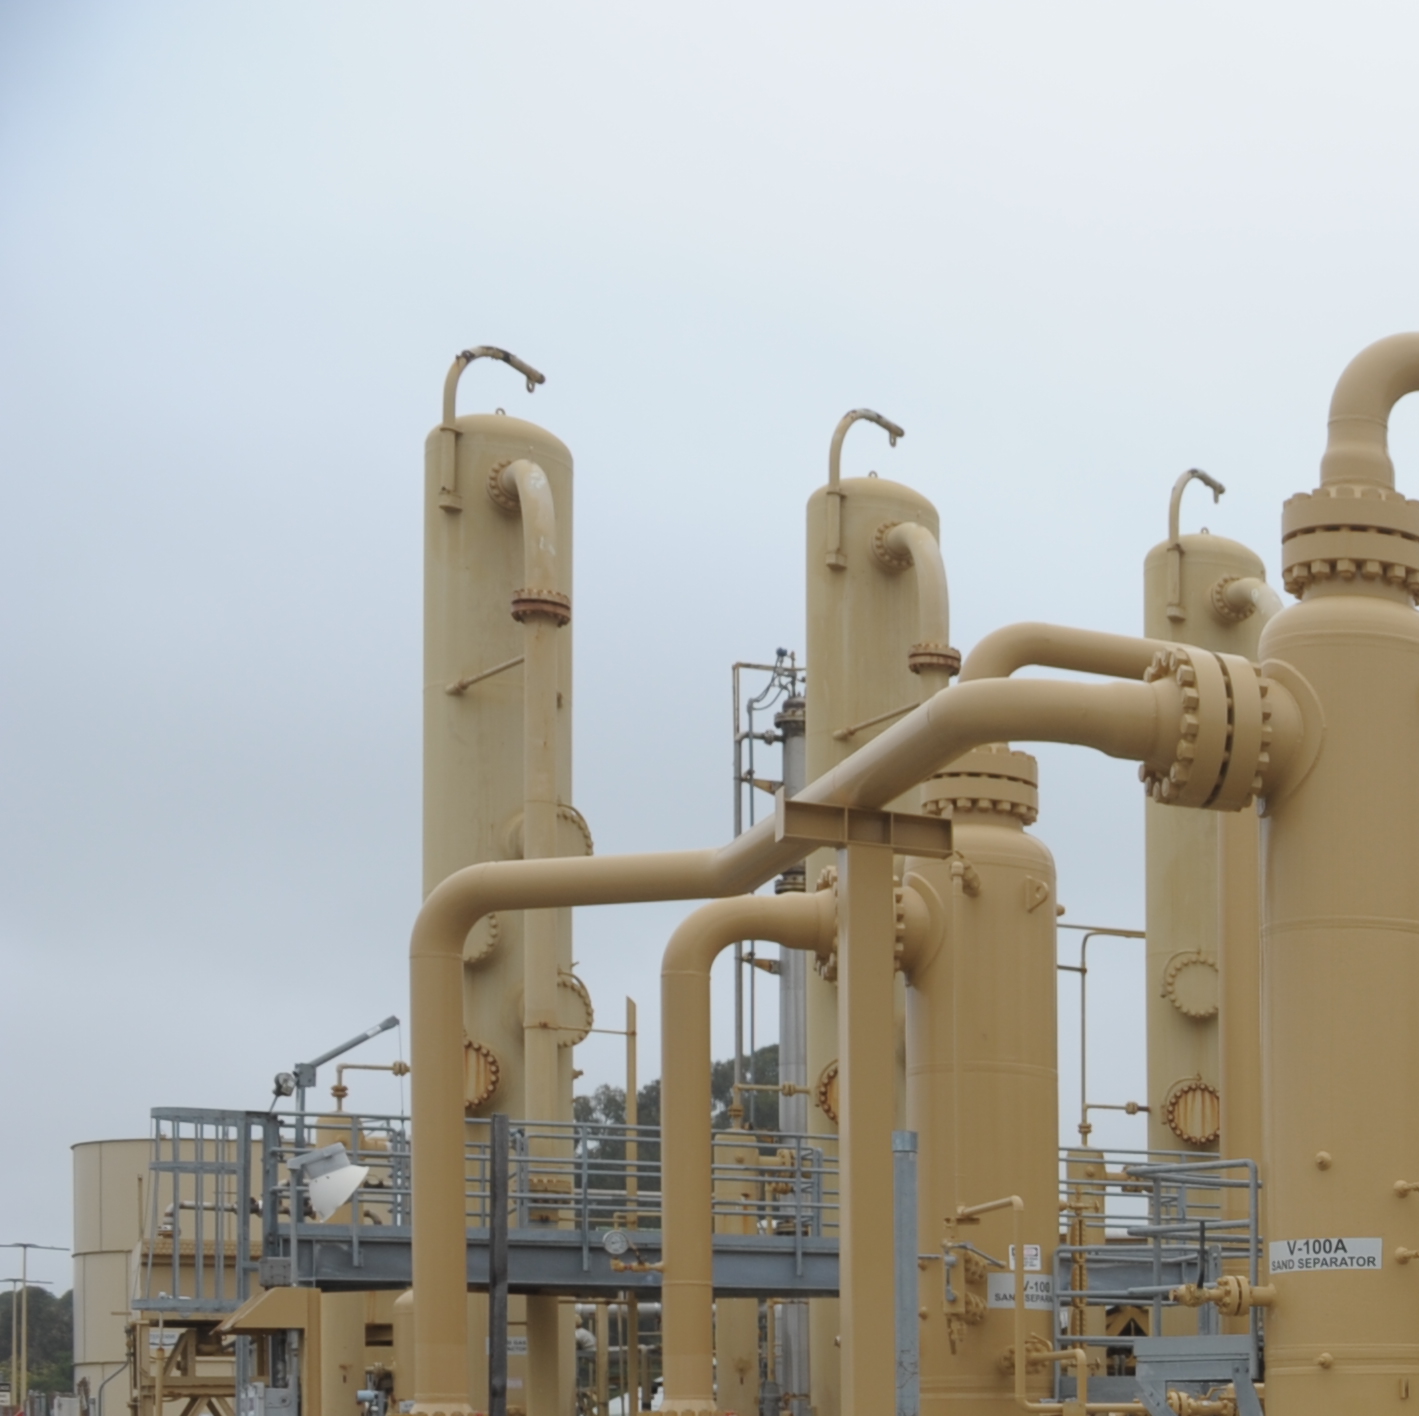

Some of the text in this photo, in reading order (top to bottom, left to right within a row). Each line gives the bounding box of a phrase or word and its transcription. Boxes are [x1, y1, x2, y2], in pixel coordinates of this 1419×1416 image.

[1287, 1238, 1348, 1256] V-100A
[1271, 1256, 1377, 1271] SAND SEPARATOR
